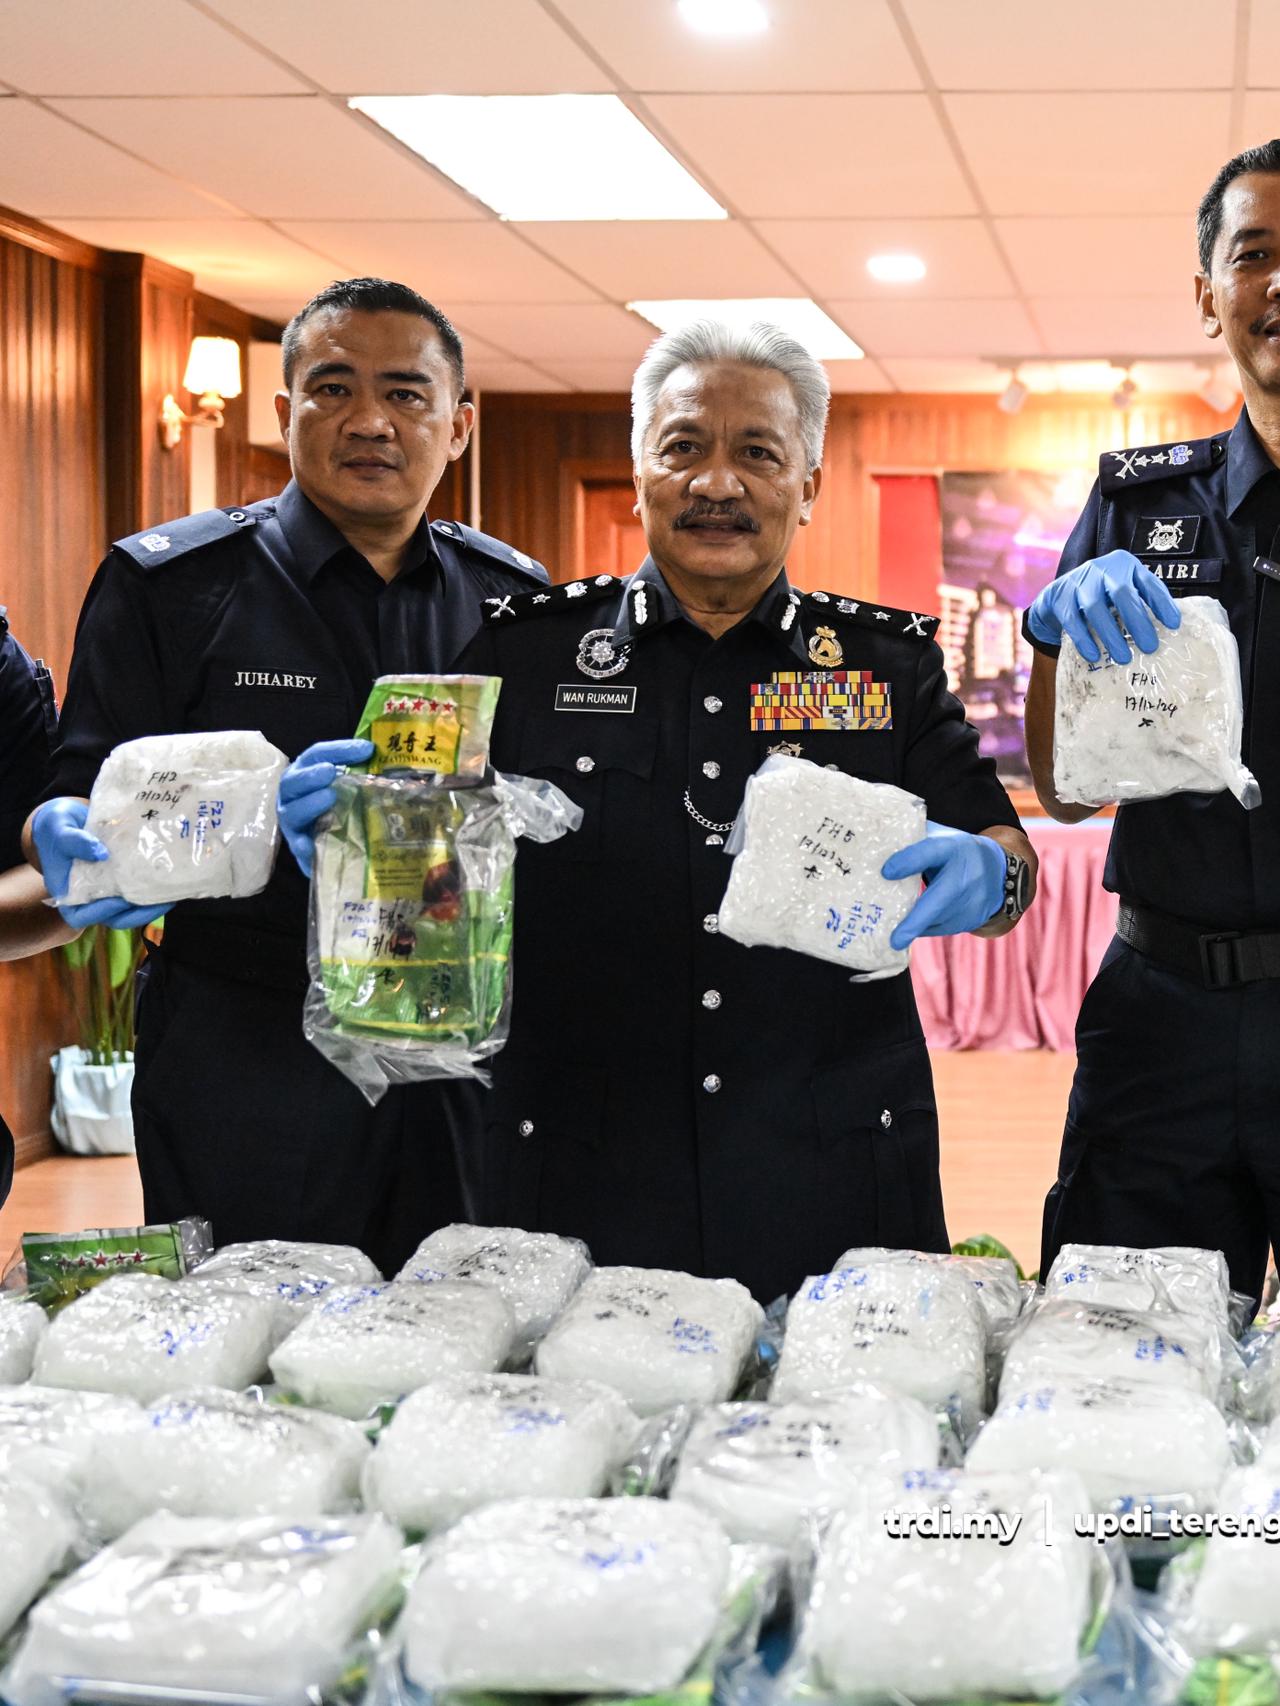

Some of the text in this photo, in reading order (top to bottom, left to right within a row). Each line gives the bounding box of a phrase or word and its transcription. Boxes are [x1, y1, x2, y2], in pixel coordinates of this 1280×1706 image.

[1146, 563, 1200, 580] AIRI
[234, 671, 317, 689] JUHAREY
[562, 691, 628, 705] WAN RUKMAN
[1125, 695, 1178, 718] 17/12/24
